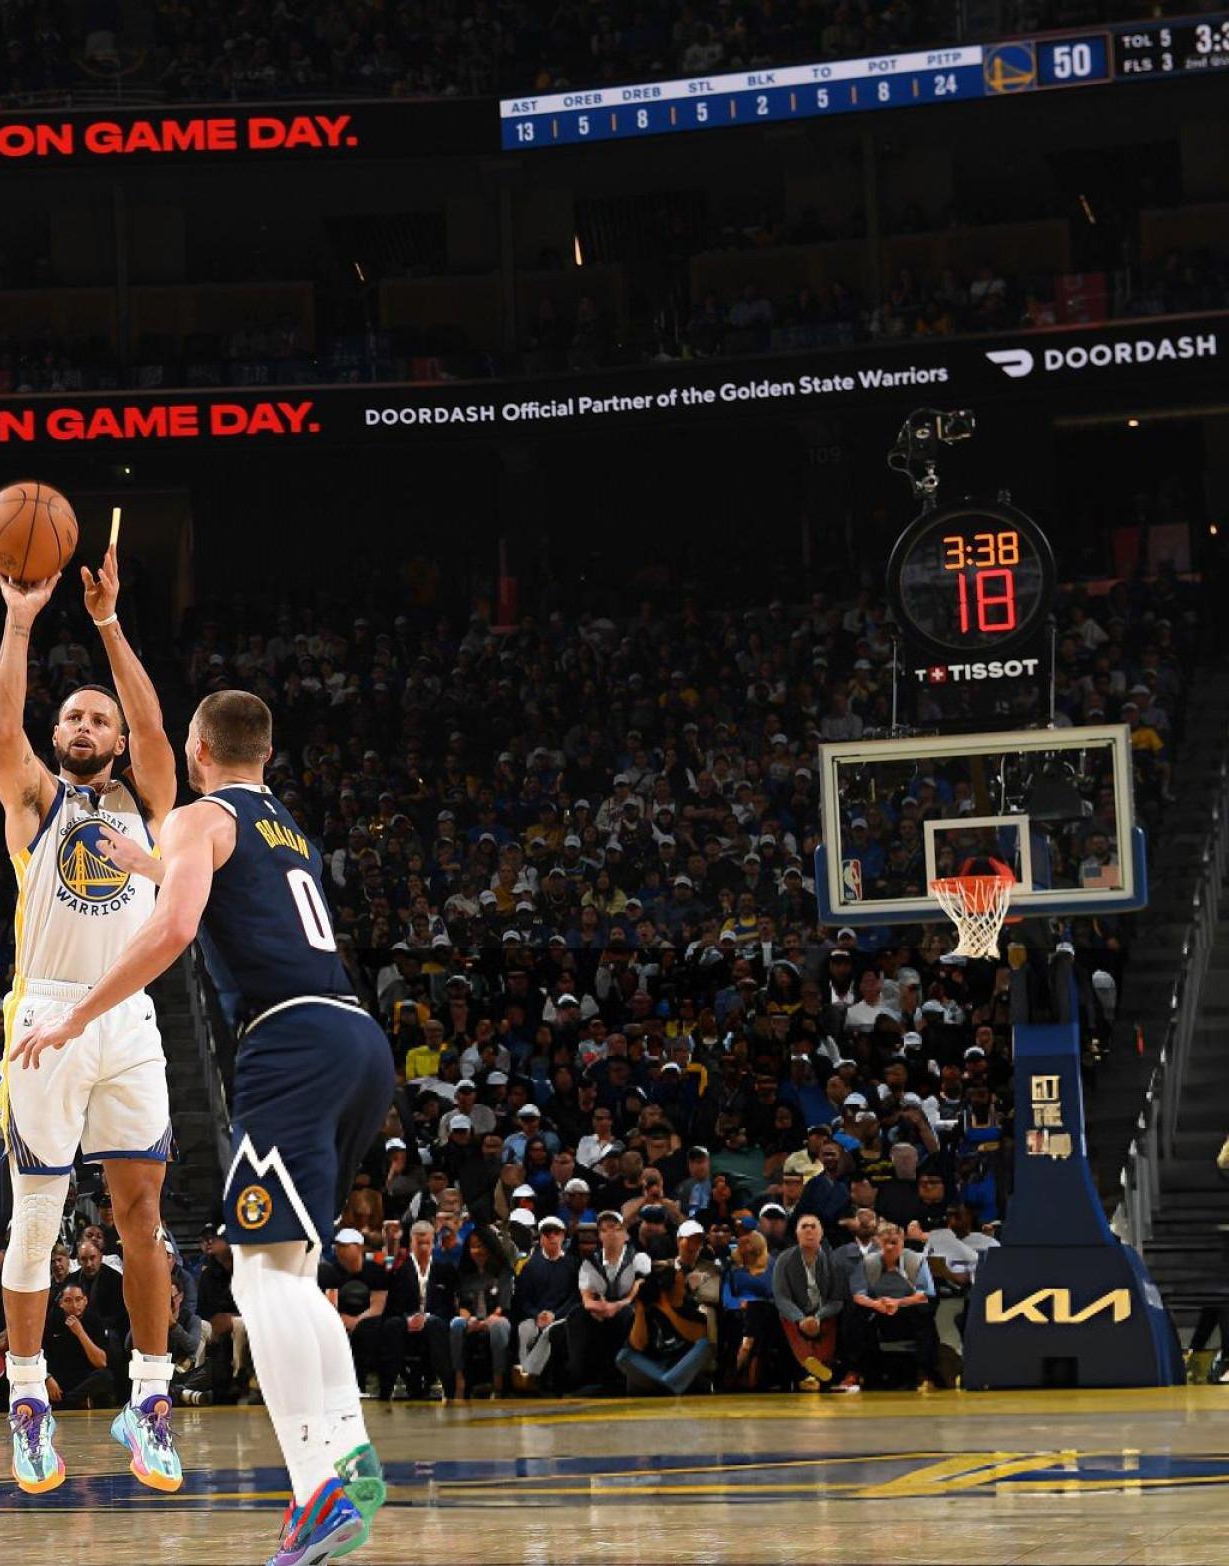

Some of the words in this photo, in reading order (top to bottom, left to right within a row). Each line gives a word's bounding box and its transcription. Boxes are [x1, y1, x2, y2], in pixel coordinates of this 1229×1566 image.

[1122, 34, 1153, 48] TOL
[1053, 43, 1091, 79] 50
[1162, 51, 1173, 72] 3
[511, 101, 538, 112] AST
[563, 93, 603, 108] OREB
[622, 87, 661, 101] DREB
[688, 81, 714, 93] STL
[747, 73, 775, 86] BLK
[811, 67, 832, 79] TO
[868, 59, 898, 73] POT
[927, 52, 962, 66] PITP
[516, 122, 534, 142] 13
[578, 116, 590, 135] 5
[636, 109, 649, 128] 8
[696, 103, 708, 122] 5
[756, 96, 768, 115] 2
[817, 89, 829, 108] 5
[877, 82, 890, 101] 8
[934, 74, 957, 95] 24
[85, 119, 237, 153] GAME
[249, 116, 357, 148] DAY.
[1044, 334, 1217, 371] DOORDASH
[365, 405, 495, 426] DOORDASH
[501, 398, 574, 421] Official
[578, 395, 653, 414] Partner
[656, 389, 678, 408] of
[681, 388, 716, 406] the
[719, 380, 795, 402] Golden
[799, 375, 855, 394] State
[858, 367, 949, 388] Warriors
[47, 406, 198, 440] GAME
[211, 402, 319, 435] DAY.
[943, 531, 1019, 570] 3:38
[958, 569, 1016, 634] 18
[948, 658, 1039, 681] TISSOT
[101, 811, 130, 835] STATE
[56, 885, 136, 916] WARRIORS
[286, 868, 337, 952] 0
[985, 1288, 1132, 1324] KIA
